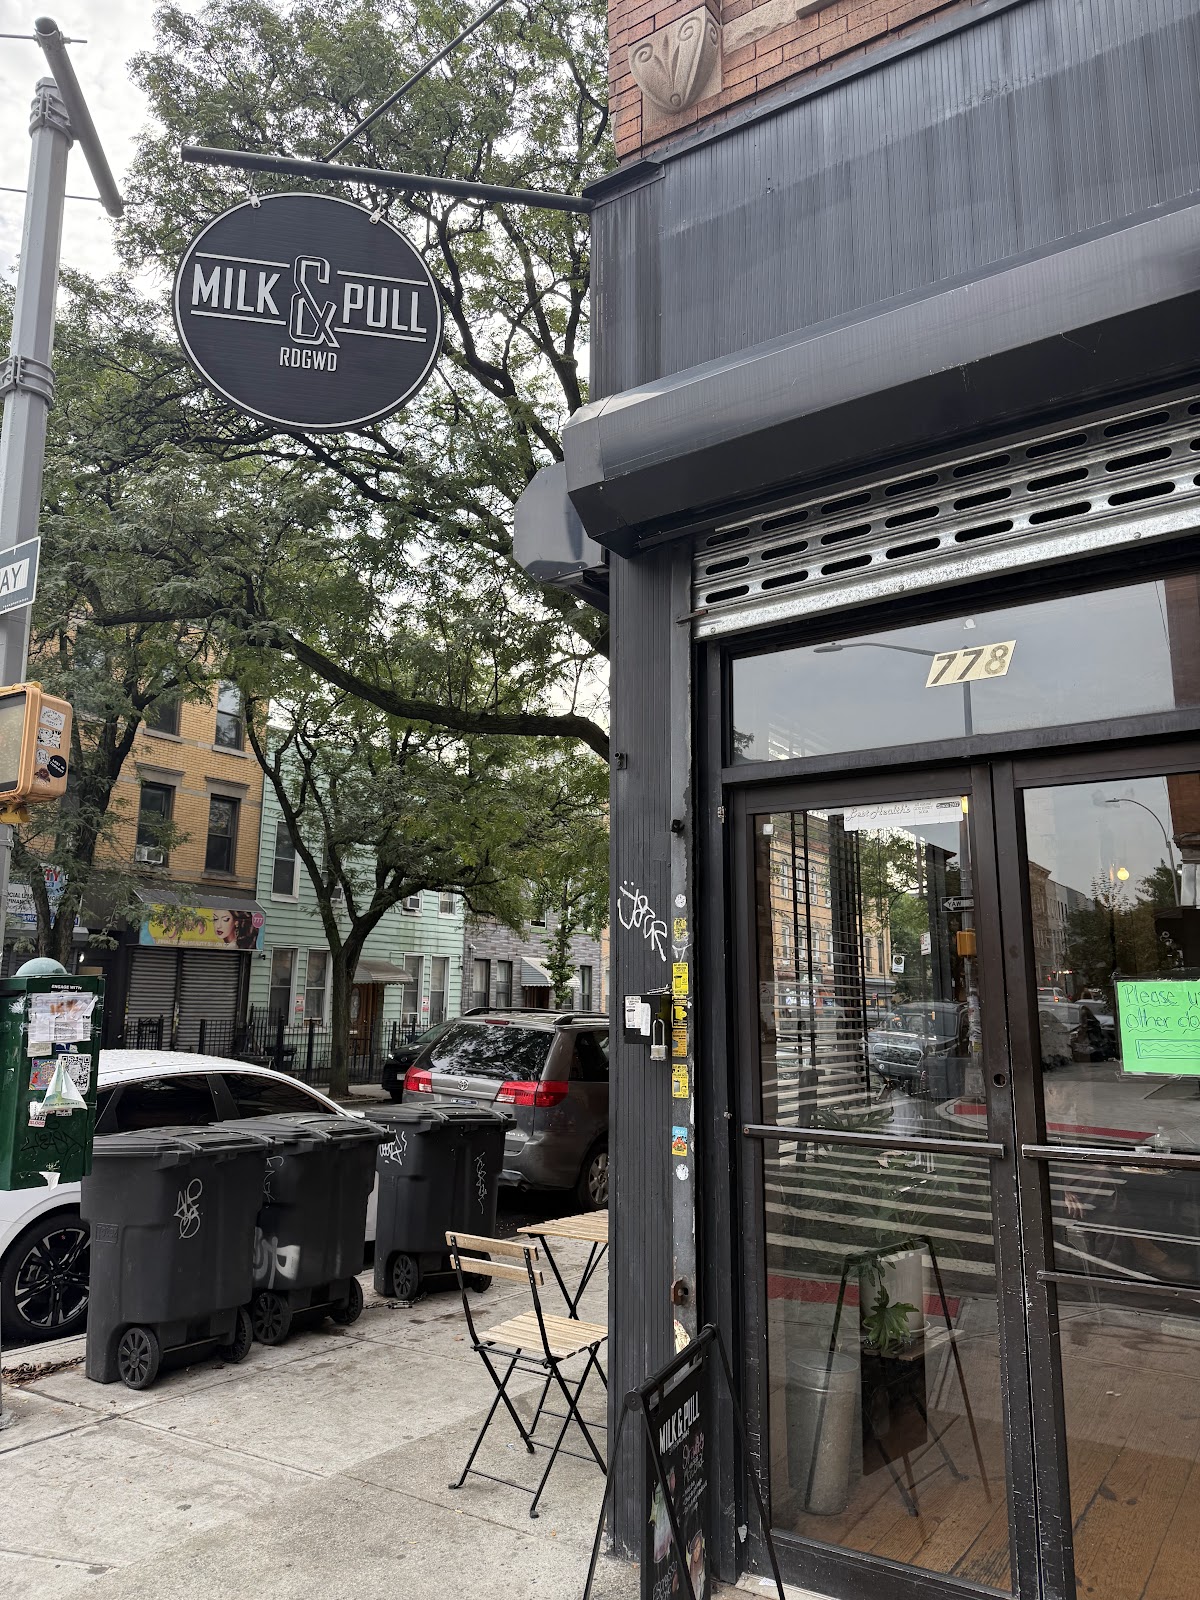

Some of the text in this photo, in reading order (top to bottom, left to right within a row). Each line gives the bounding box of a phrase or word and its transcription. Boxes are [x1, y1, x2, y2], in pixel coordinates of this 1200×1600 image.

[191, 255, 427, 348] MILK & PULL
[279, 346, 338, 372] RDGWD
[0, 564, 22, 594] AY
[930, 644, 1009, 685] 778
[1121, 983, 1200, 1006] Please u
[659, 1412, 677, 1456] MILK
[677, 1407, 683, 1438] &
[683, 1390, 700, 1432] PULL
